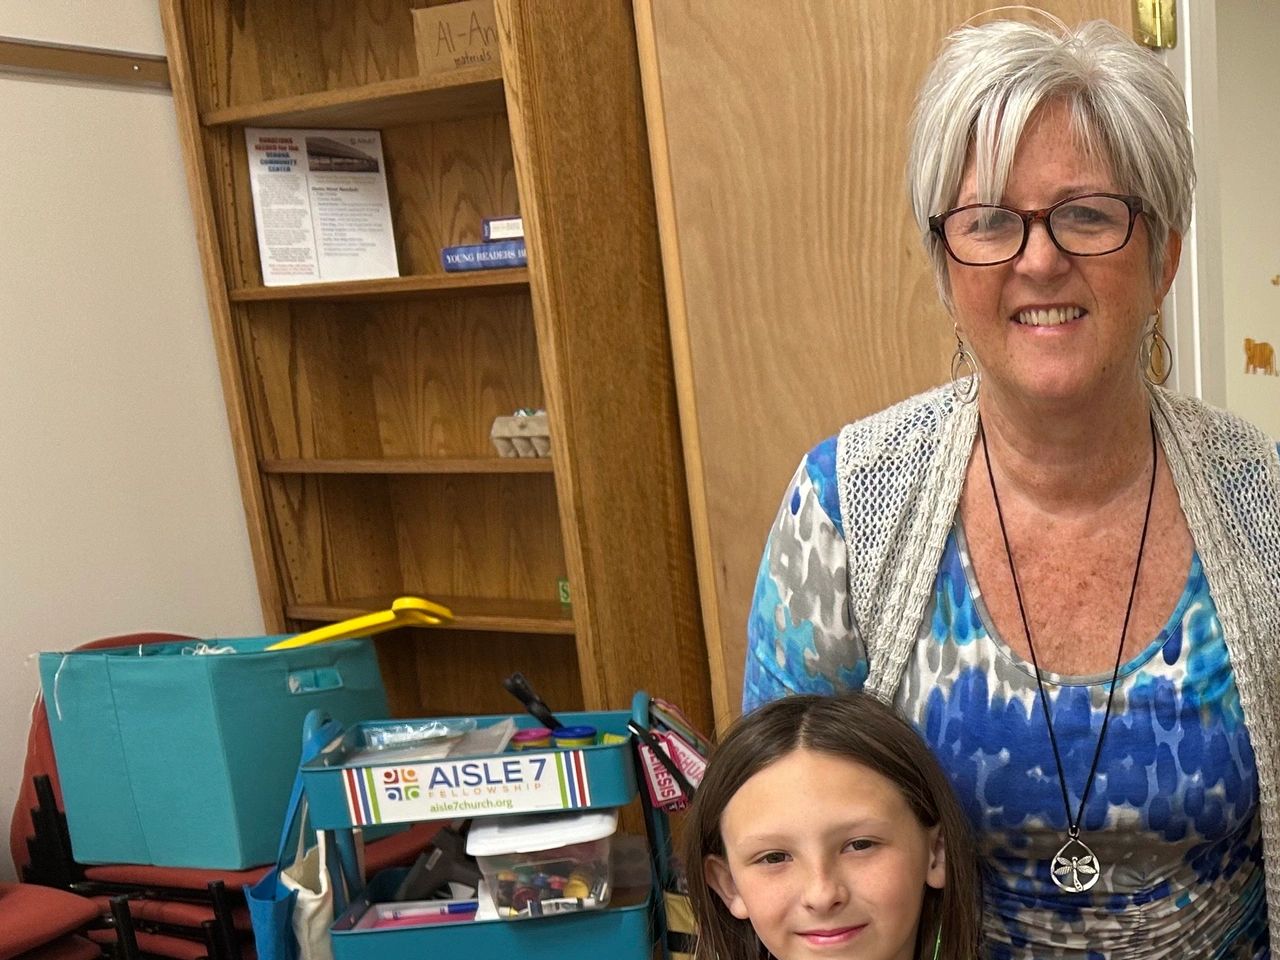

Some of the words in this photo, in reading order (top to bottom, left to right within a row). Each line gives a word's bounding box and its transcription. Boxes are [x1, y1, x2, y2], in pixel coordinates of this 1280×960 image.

[446, 253, 474, 264] YOUNG
[476, 250, 516, 262] READERS
[428, 760, 523, 789] AISLE
[529, 758, 547, 781] 7
[648, 747, 676, 797] ENESIS
[428, 783, 542, 798] FELLOWSHIP
[430, 798, 513, 813] aisle7church.org
